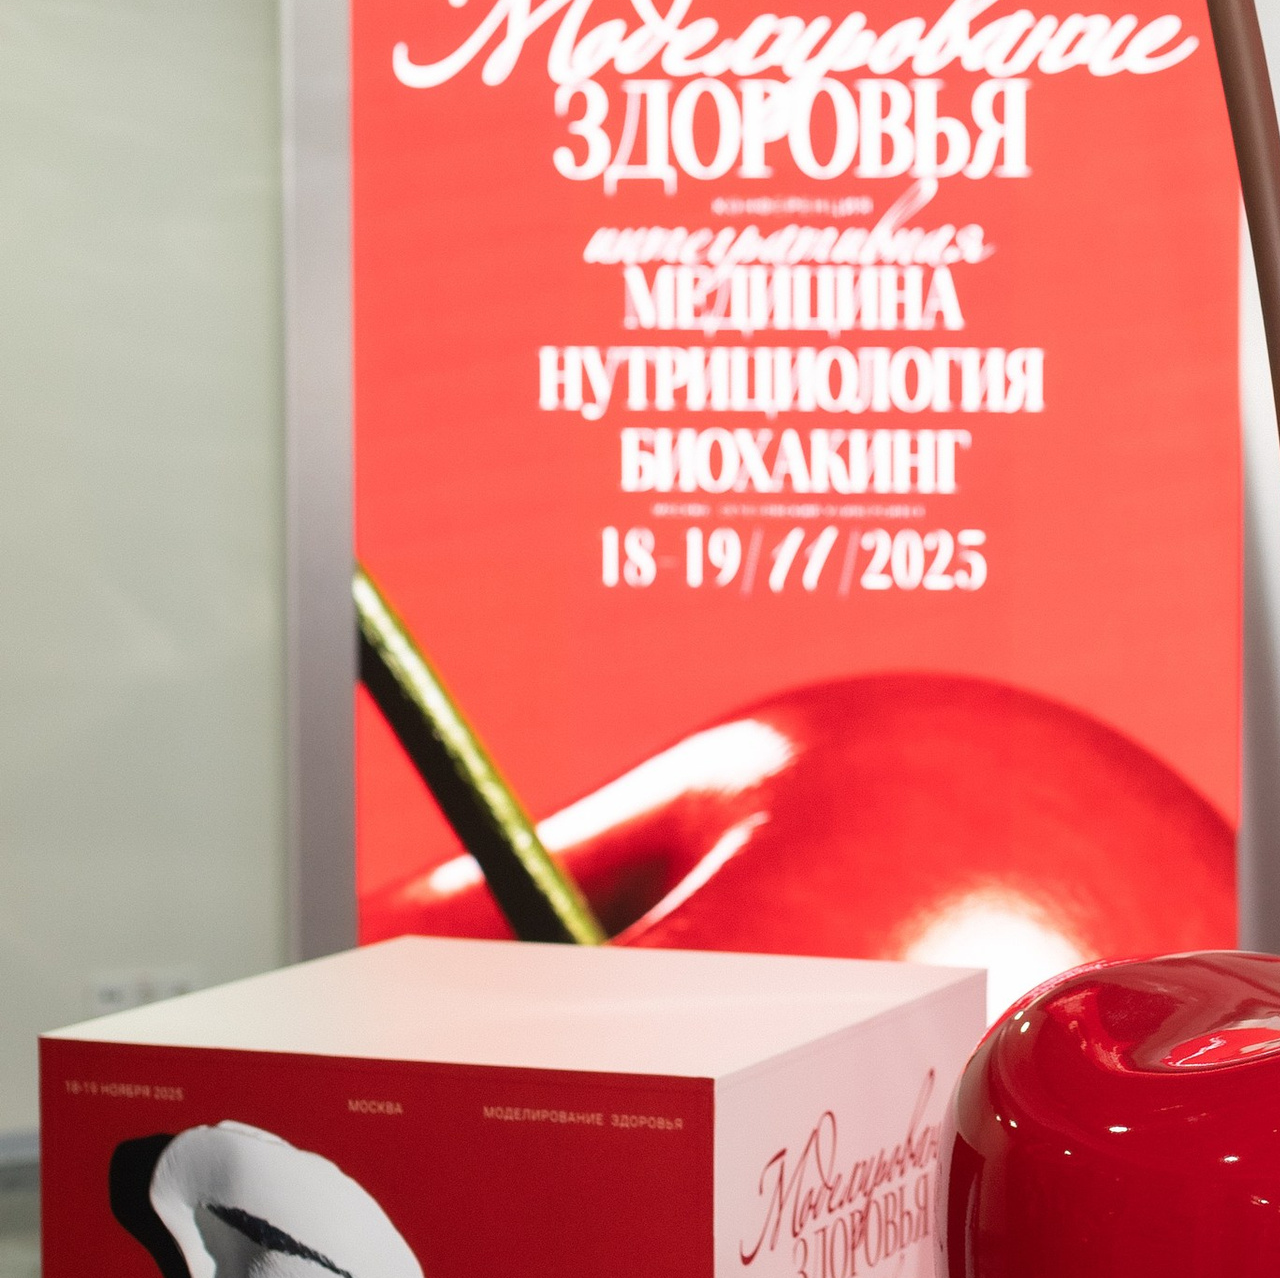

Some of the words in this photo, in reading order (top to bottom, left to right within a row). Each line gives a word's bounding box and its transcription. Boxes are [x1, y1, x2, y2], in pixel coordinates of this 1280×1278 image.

[551, 76, 1031, 195] ЗДОРОВЬЯ
[624, 264, 965, 339] МЕДИЦИНА
[537, 346, 1045, 420] НУТРИЦИОЛОГИЯ
[619, 428, 971, 495] БИОХАКИНГ
[348, 1098, 403, 1115] МОСКВА
[483, 1105, 604, 1126] МОДЕЛИРОВАНИЕ
[610, 1113, 683, 1130] ЗДОРОВЬЯ
